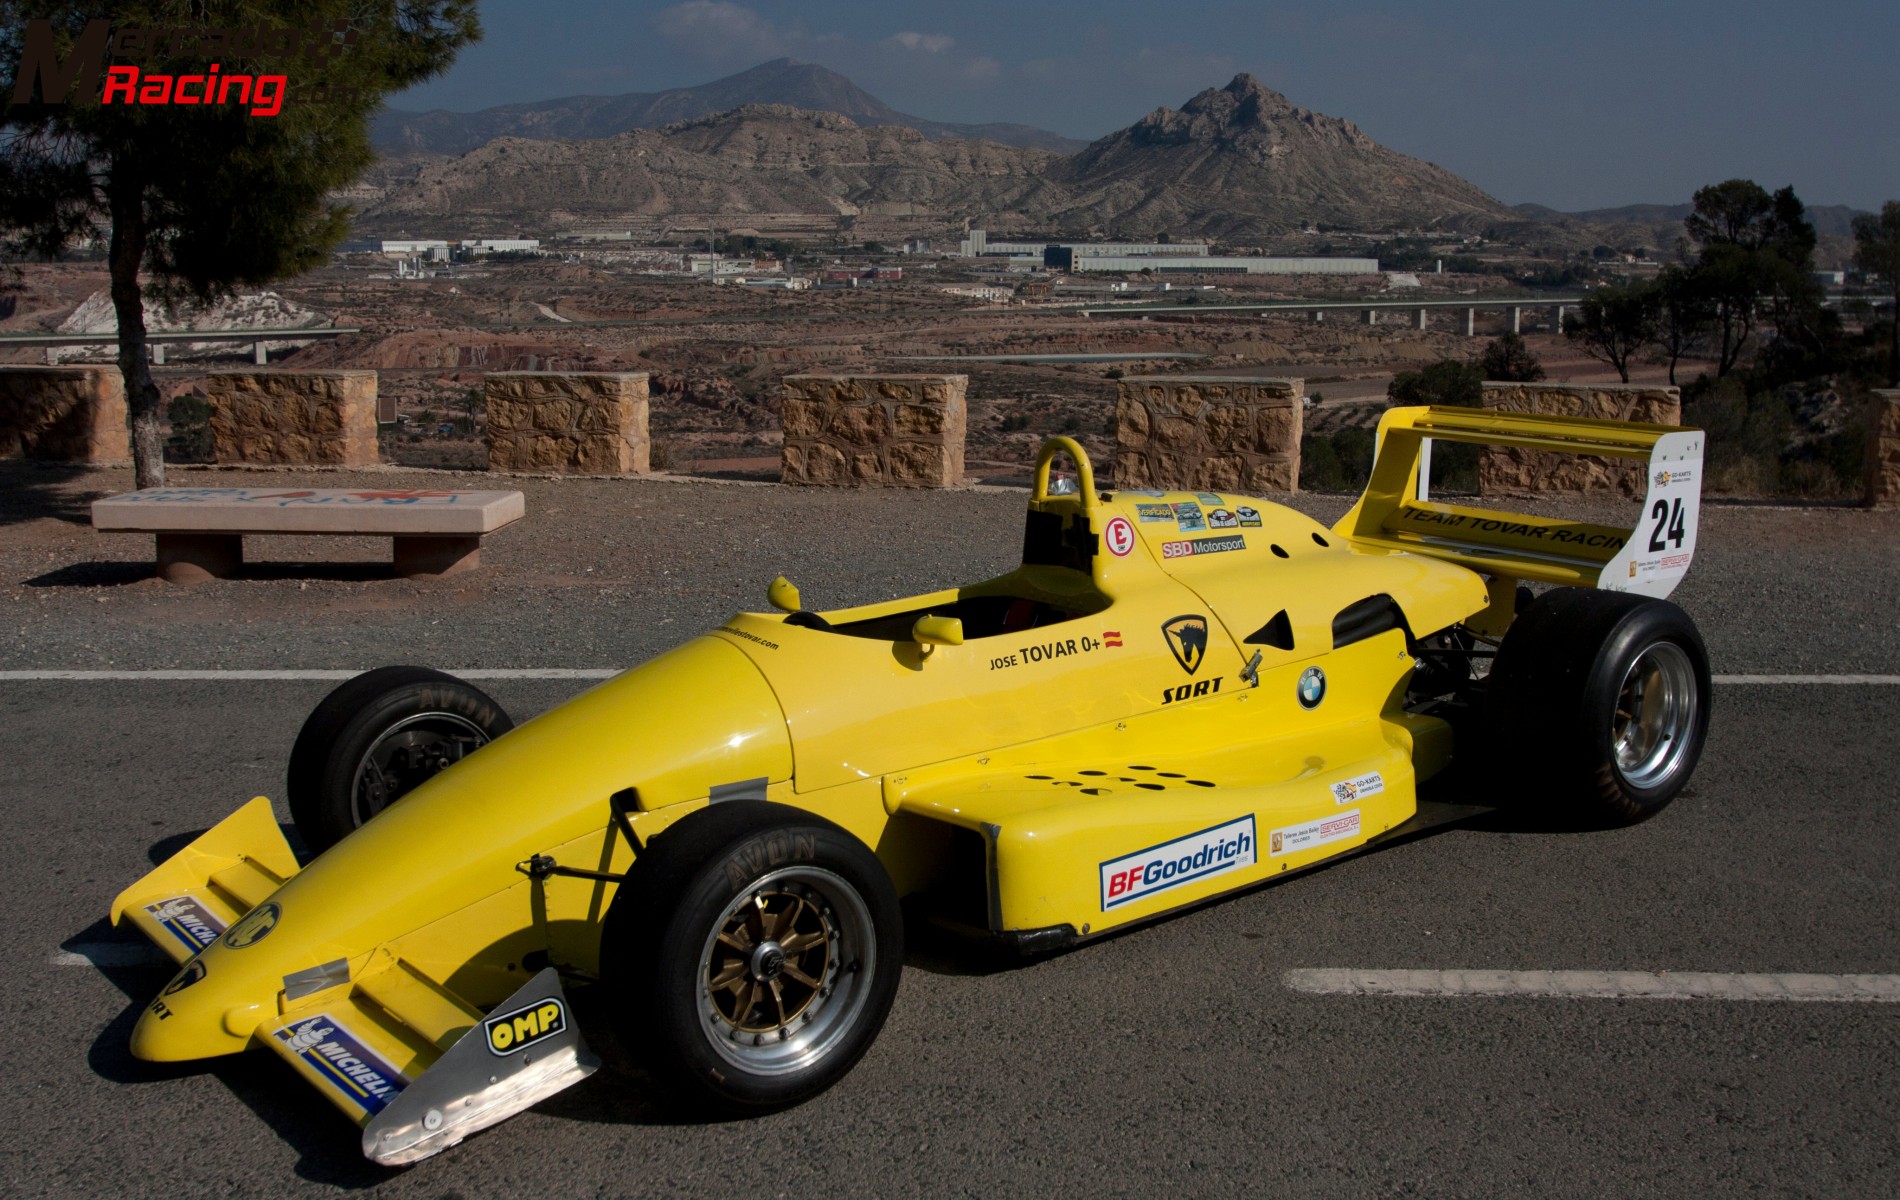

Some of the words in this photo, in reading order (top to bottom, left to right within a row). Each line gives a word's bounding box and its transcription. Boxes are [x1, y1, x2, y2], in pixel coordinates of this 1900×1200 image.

[1114, 523, 1127, 545] E
[1403, 506, 1463, 526] TEAM
[1469, 517, 1549, 539] TOVAR
[1550, 529, 1625, 550] RACIN
[1649, 497, 1685, 553] 24
[990, 655, 1018, 670] JOSE
[1019, 637, 1078, 664] TOVAR
[1161, 677, 1223, 705] SORT
[1299, 669, 1324, 685] BMW
[419, 688, 497, 729] AVON
[1356, 775, 1381, 788] GO-KARTS
[722, 828, 816, 891] AVON
[1107, 833, 1251, 898] BFGoodrich
[176, 913, 218, 945] MICH
[491, 1003, 559, 1049] OMP
